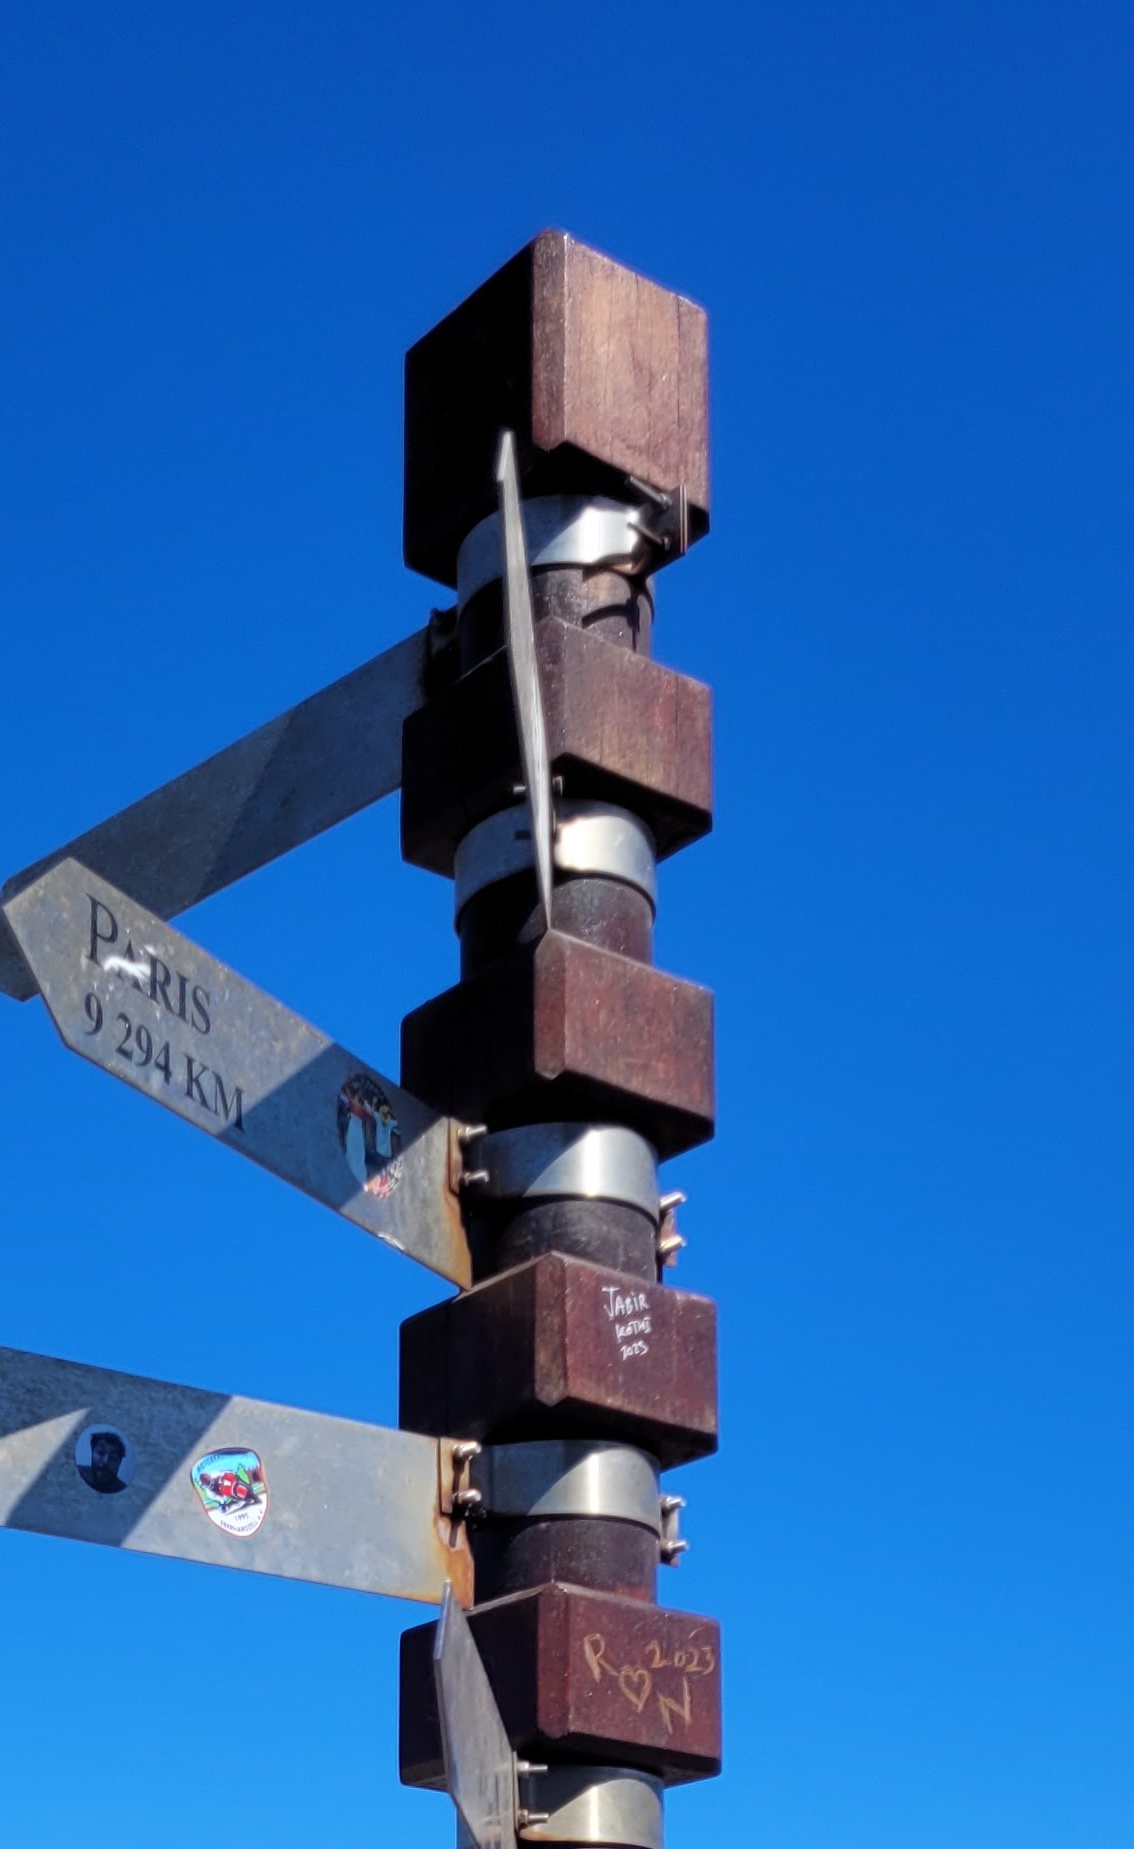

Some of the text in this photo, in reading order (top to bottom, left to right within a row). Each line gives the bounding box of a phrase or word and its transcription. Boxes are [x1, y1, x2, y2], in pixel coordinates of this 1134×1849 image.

[85, 893, 212, 1035] PARIS
[84, 992, 245, 1132] 9 294 KM
